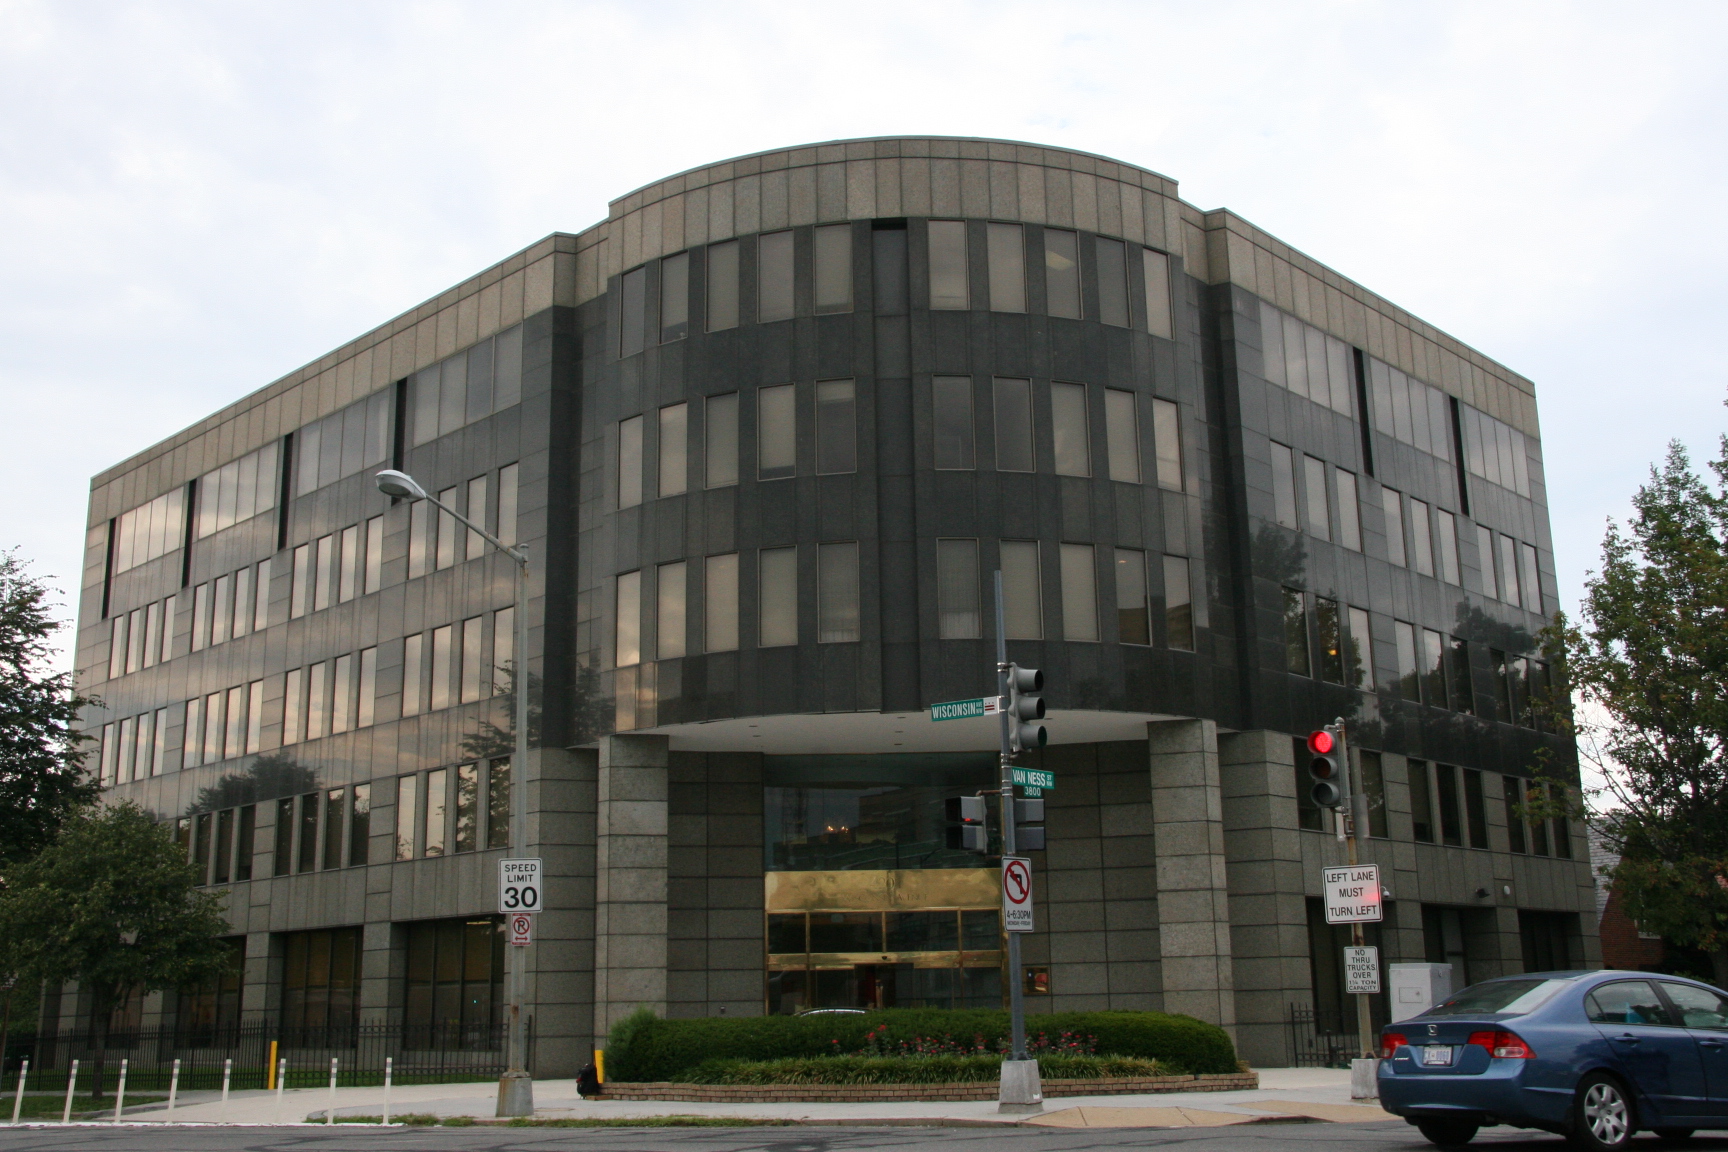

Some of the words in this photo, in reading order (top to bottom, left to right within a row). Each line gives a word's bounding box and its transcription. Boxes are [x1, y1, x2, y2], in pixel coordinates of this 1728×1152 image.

[932, 703, 976, 719] WISCONSIN
[1012, 769, 1026, 784] VAN
[1027, 771, 1046, 786] NESS
[1025, 786, 1041, 796] 3800
[504, 864, 537, 872] SPEED
[507, 874, 534, 883] LIMIT
[1326, 872, 1347, 883] LEFT
[1351, 871, 1374, 882] LANE
[504, 886, 538, 909] 30
[1339, 887, 1363, 897] MUST
[1329, 906, 1353, 917] TURN
[1356, 905, 1377, 916] LEFT
[1351, 956, 1370, 964] THRU
